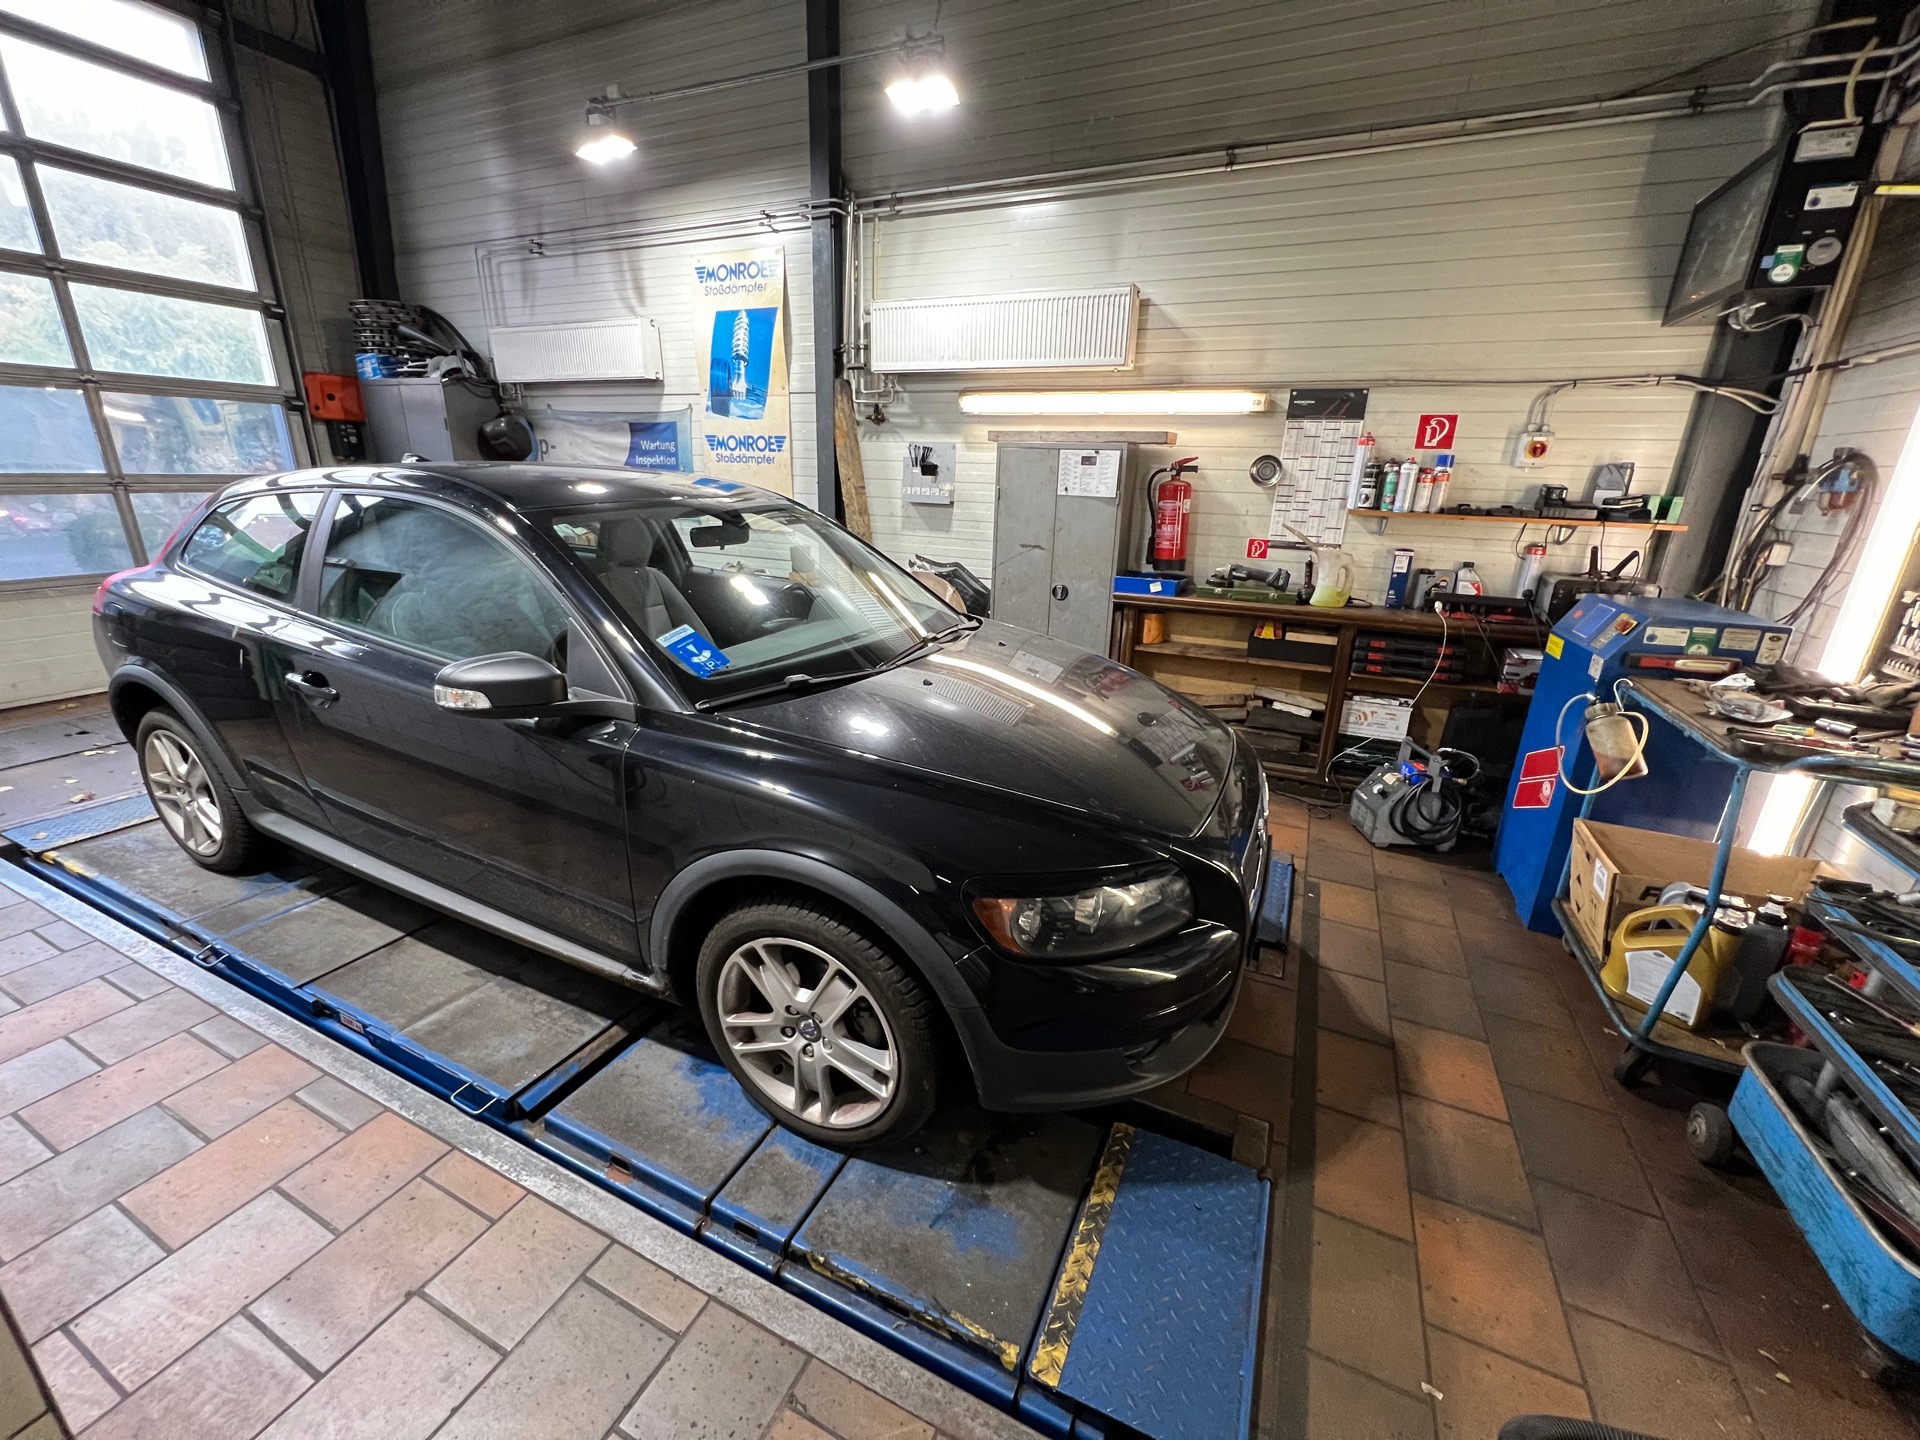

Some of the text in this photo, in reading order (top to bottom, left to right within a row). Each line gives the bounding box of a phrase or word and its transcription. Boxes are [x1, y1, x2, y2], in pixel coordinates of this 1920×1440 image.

[705, 260, 769, 283] MONROE
[704, 281, 768, 296] Stoßdämpfer
[640, 440, 676, 452] Wartung
[715, 434, 777, 453] MONROE
[635, 455, 676, 467] Inspektion
[715, 453, 775, 466] Stoßdämpfer
